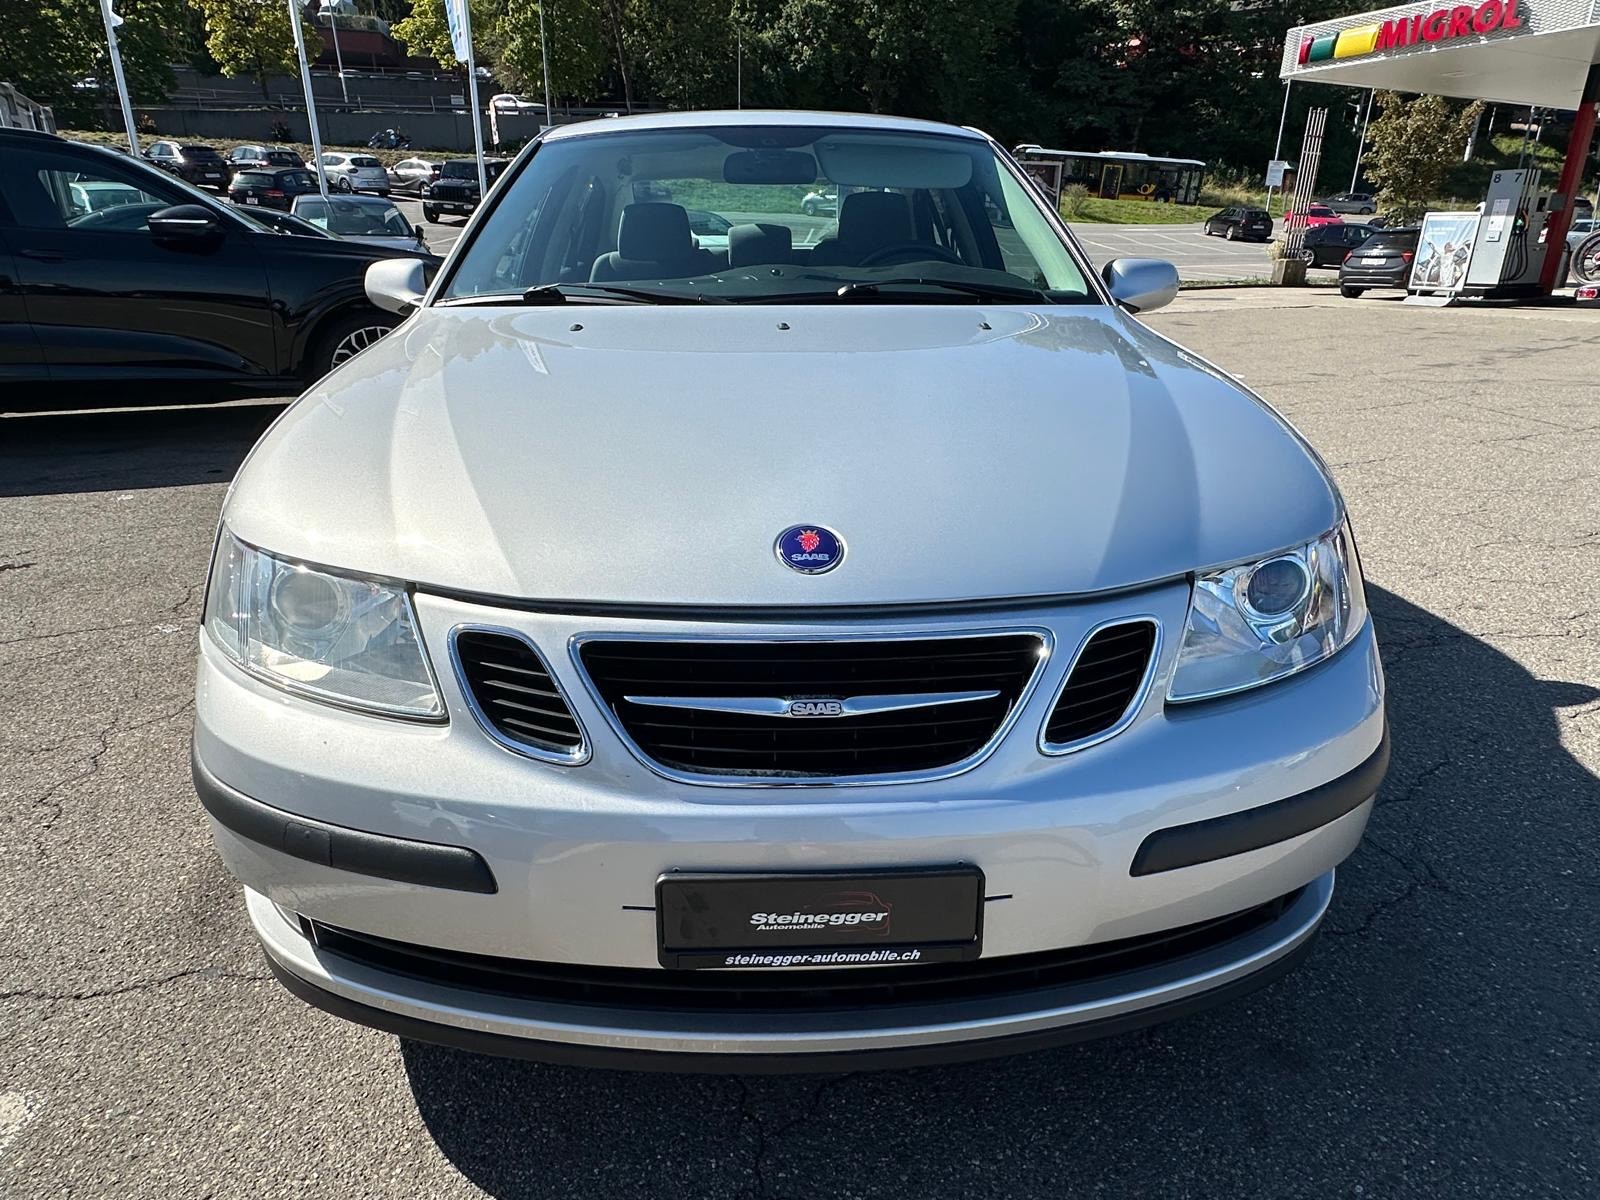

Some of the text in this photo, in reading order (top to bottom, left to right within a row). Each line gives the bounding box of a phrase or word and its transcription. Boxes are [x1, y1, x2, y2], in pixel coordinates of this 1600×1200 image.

[1375, 0, 1521, 51] MIGROL
[1493, 172, 1522, 184] 8 7
[791, 553, 830, 561] SAAB
[791, 702, 841, 715] SAAB
[750, 911, 888, 925] Steinegger
[756, 923, 825, 931] Automobile
[725, 949, 921, 966] steinegger-automobile.ch
